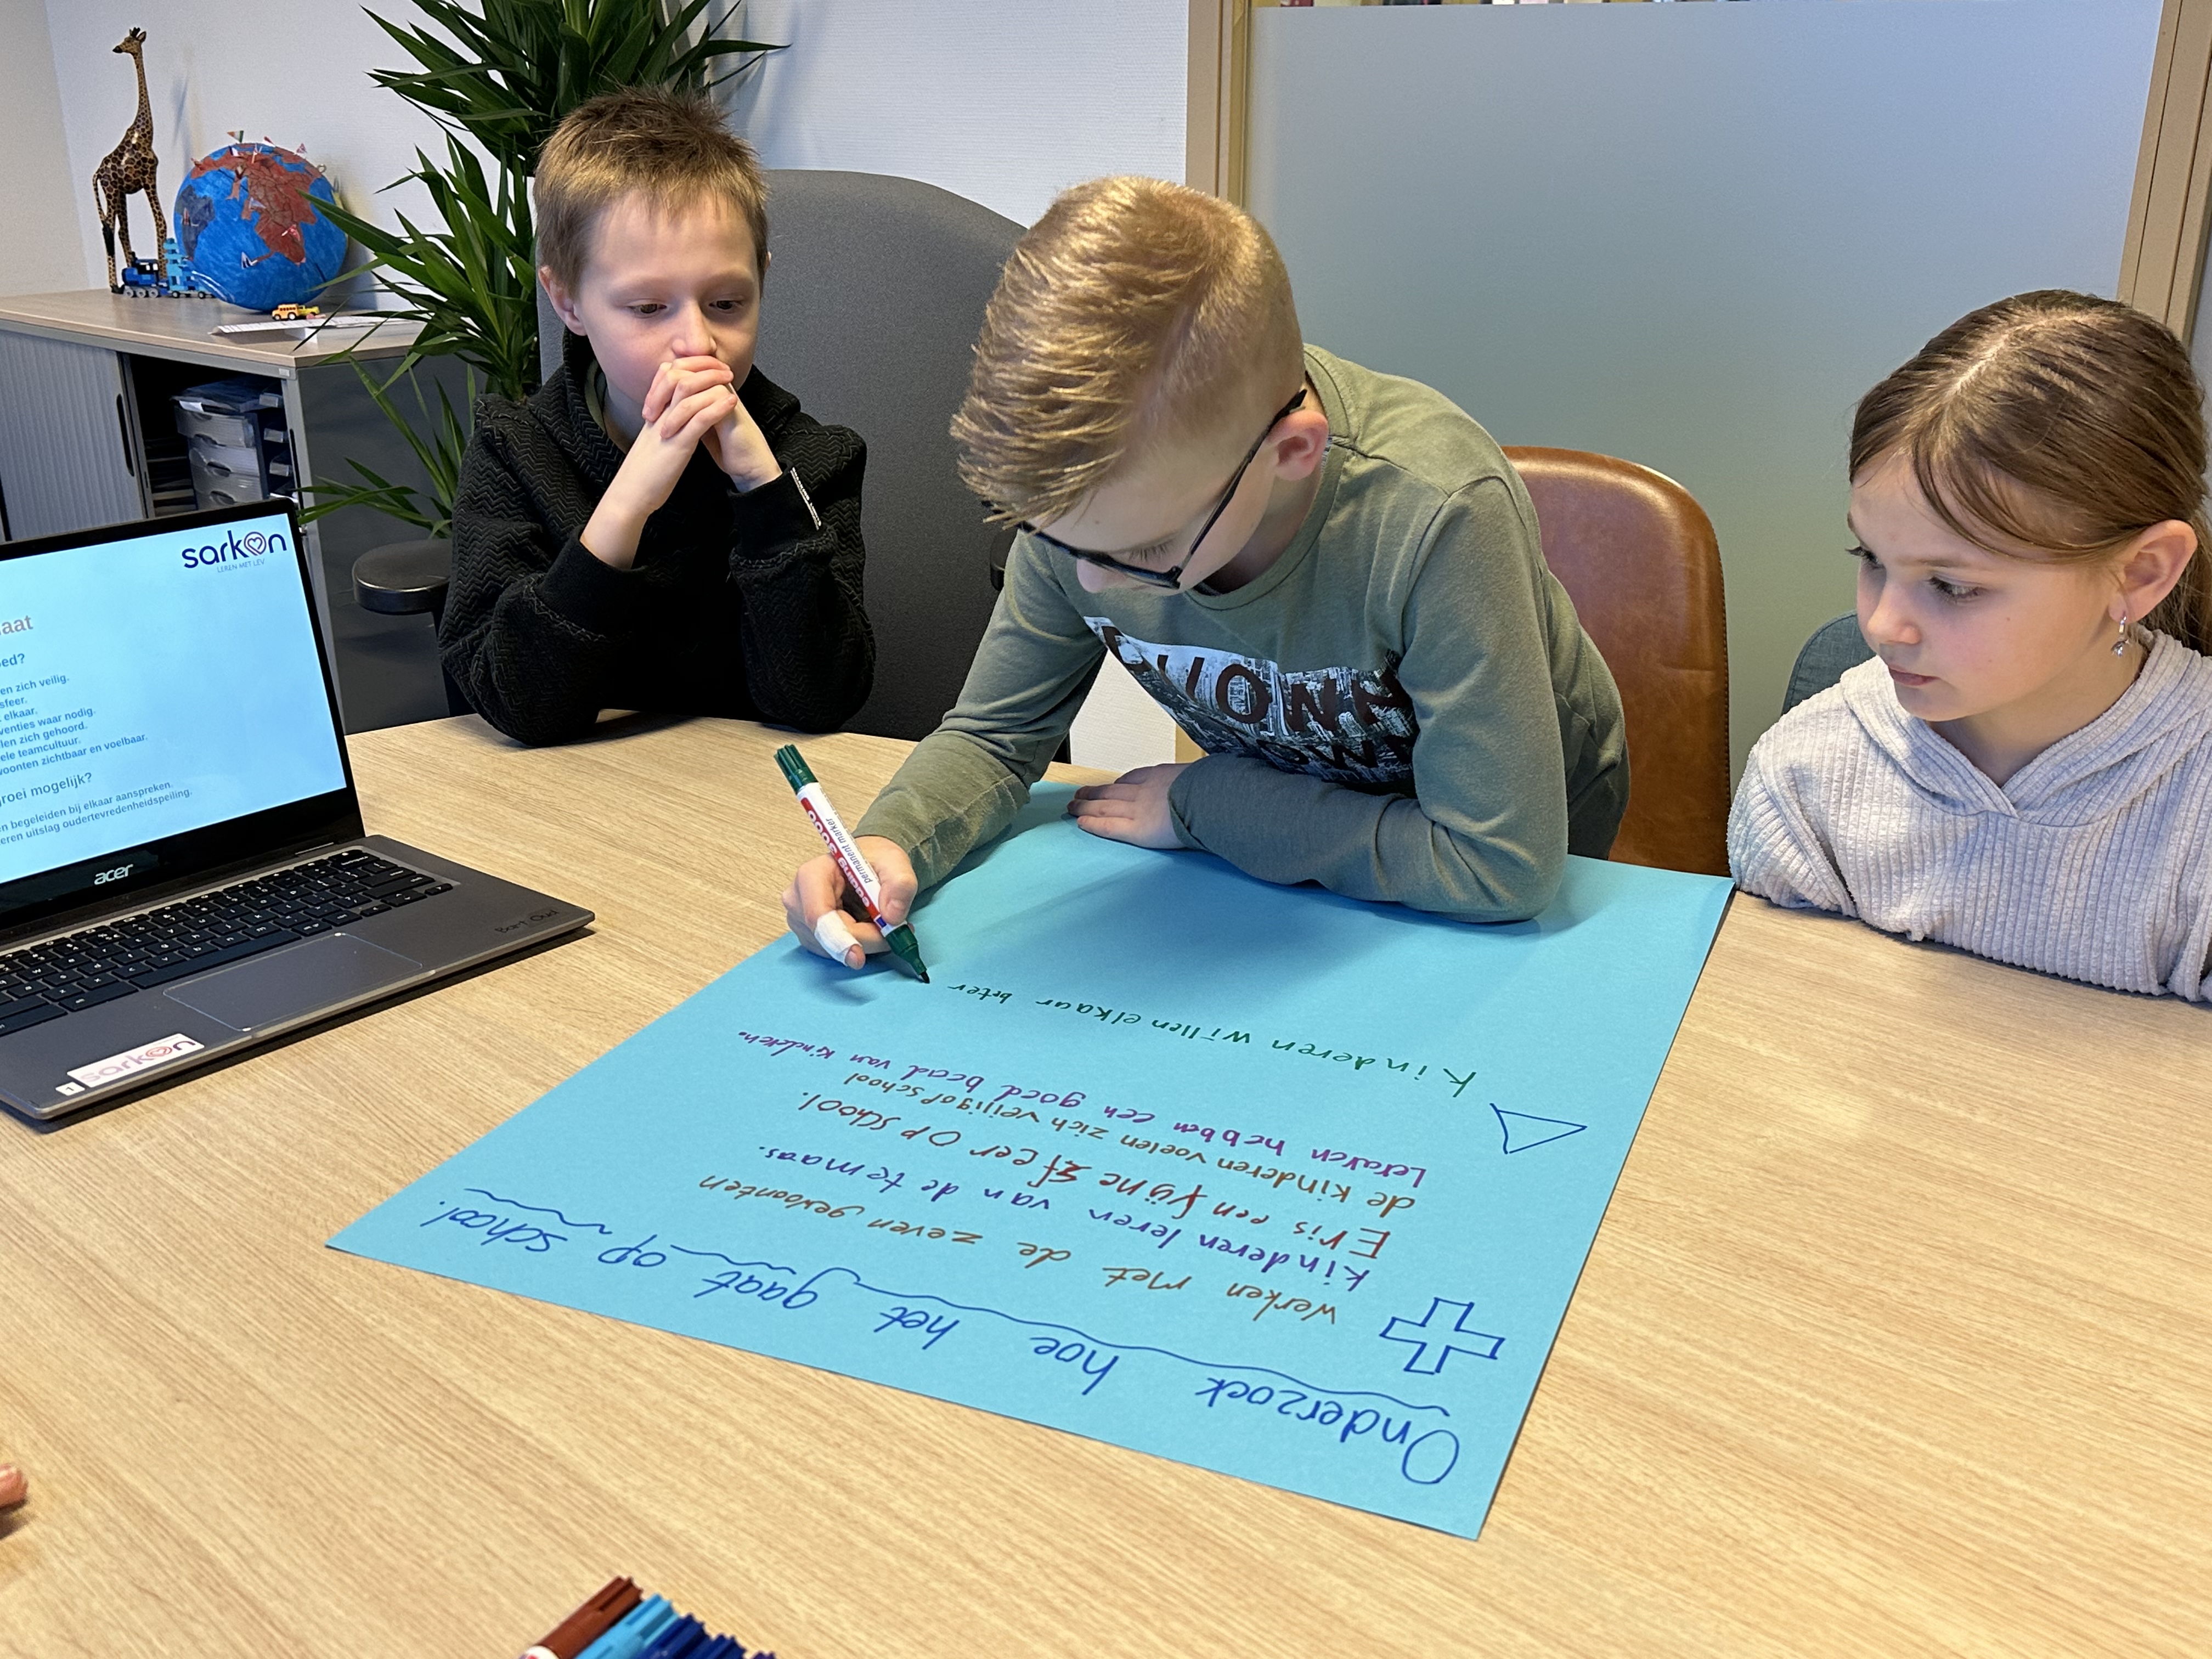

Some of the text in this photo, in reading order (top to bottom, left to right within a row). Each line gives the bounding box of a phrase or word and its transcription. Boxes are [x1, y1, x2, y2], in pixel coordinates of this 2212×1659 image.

[182, 530, 287, 568] sarkon
[0, 615, 33, 635] aat
[0, 653, 25, 667] ed?
[15, 680, 37, 692] zich
[39, 674, 70, 686] veilig.
[4, 707, 38, 721] elkaar.
[37, 715, 61, 727] waar
[65, 707, 95, 721] nodig.
[19, 732, 40, 744] zich
[43, 721, 88, 740] gehoord.
[18, 736, 81, 758] teamcultuur.
[41, 747, 87, 765] zichtbaar
[89, 746, 102, 754] en
[104, 733, 148, 750] voelbaar.
[0, 772, 92, 807] roei mogelijk?
[10, 809, 66, 830] begeleiden
[69, 805, 82, 814] bij
[84, 797, 113, 810] elkaar
[115, 781, 173, 803] aanspreken.
[26, 823, 60, 839] uitslag
[63, 788, 193, 828] oudertevredenheidspeiling.
[825, 817, 847, 845] marker
[94, 864, 133, 885] acer
[840, 844, 874, 884] permanent
[837, 856, 870, 908] edding
[1152, 1019, 1250, 1045] willen
[80, 1040, 196, 1084] sarkon
[849, 1053, 891, 1070] van
[843, 1072, 925, 1097] school
[994, 1084, 1087, 1109] goed
[1103, 1105, 1156, 1124] een
[1051, 1117, 1109, 1141] zich
[1173, 1122, 1285, 1156] hebben
[1120, 1134, 1207, 1165] voelen
[921, 1179, 960, 1203] de
[1217, 1158, 1352, 1204] kinderen
[983, 1187, 1051, 1210] van
[1367, 1192, 1416, 1218] de
[1212, 1201, 1270, 1226] een
[866, 1218, 984, 1245] zeven
[1088, 1209, 1182, 1249] leren
[597, 1234, 668, 1269] op
[1016, 1242, 1071, 1269] de
[693, 1267, 861, 1311] gaat
[873, 1306, 961, 1350] het
[1028, 1336, 1120, 1396] hoe
[1194, 1376, 1460, 1485] Onderzoek
